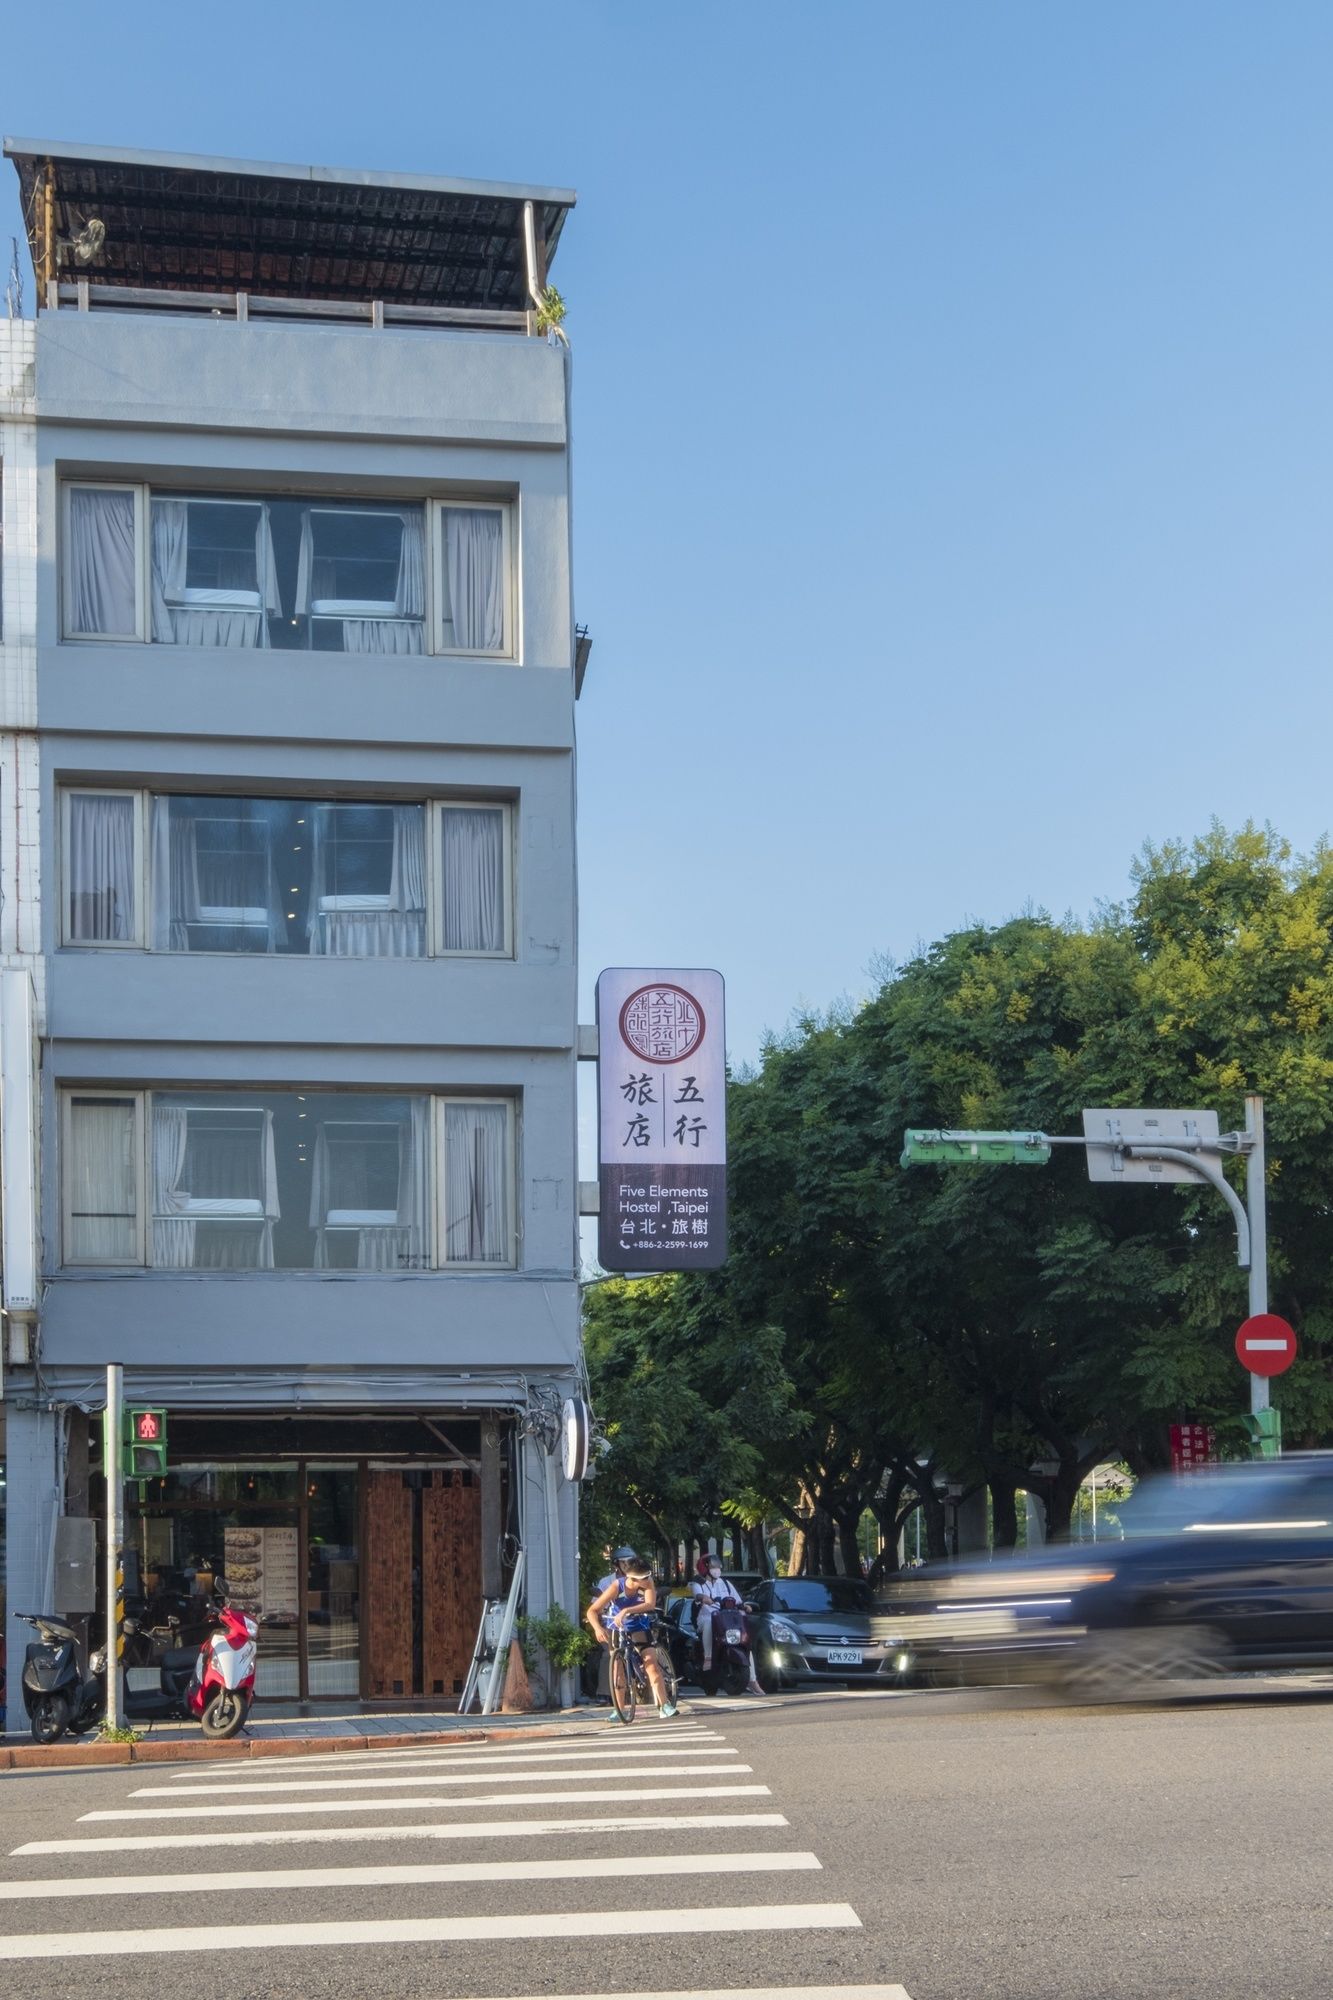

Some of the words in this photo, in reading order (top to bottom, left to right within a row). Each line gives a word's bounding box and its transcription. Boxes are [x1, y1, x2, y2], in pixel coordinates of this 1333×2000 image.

[619, 1073, 658, 1148] 旅店
[673, 1076, 708, 1148] 五行
[620, 1185, 646, 1197] Five
[649, 1185, 709, 1197] Elements
[620, 1201, 660, 1213] Hostel
[633, 1241, 709, 1249] +886-2-2599-1699
